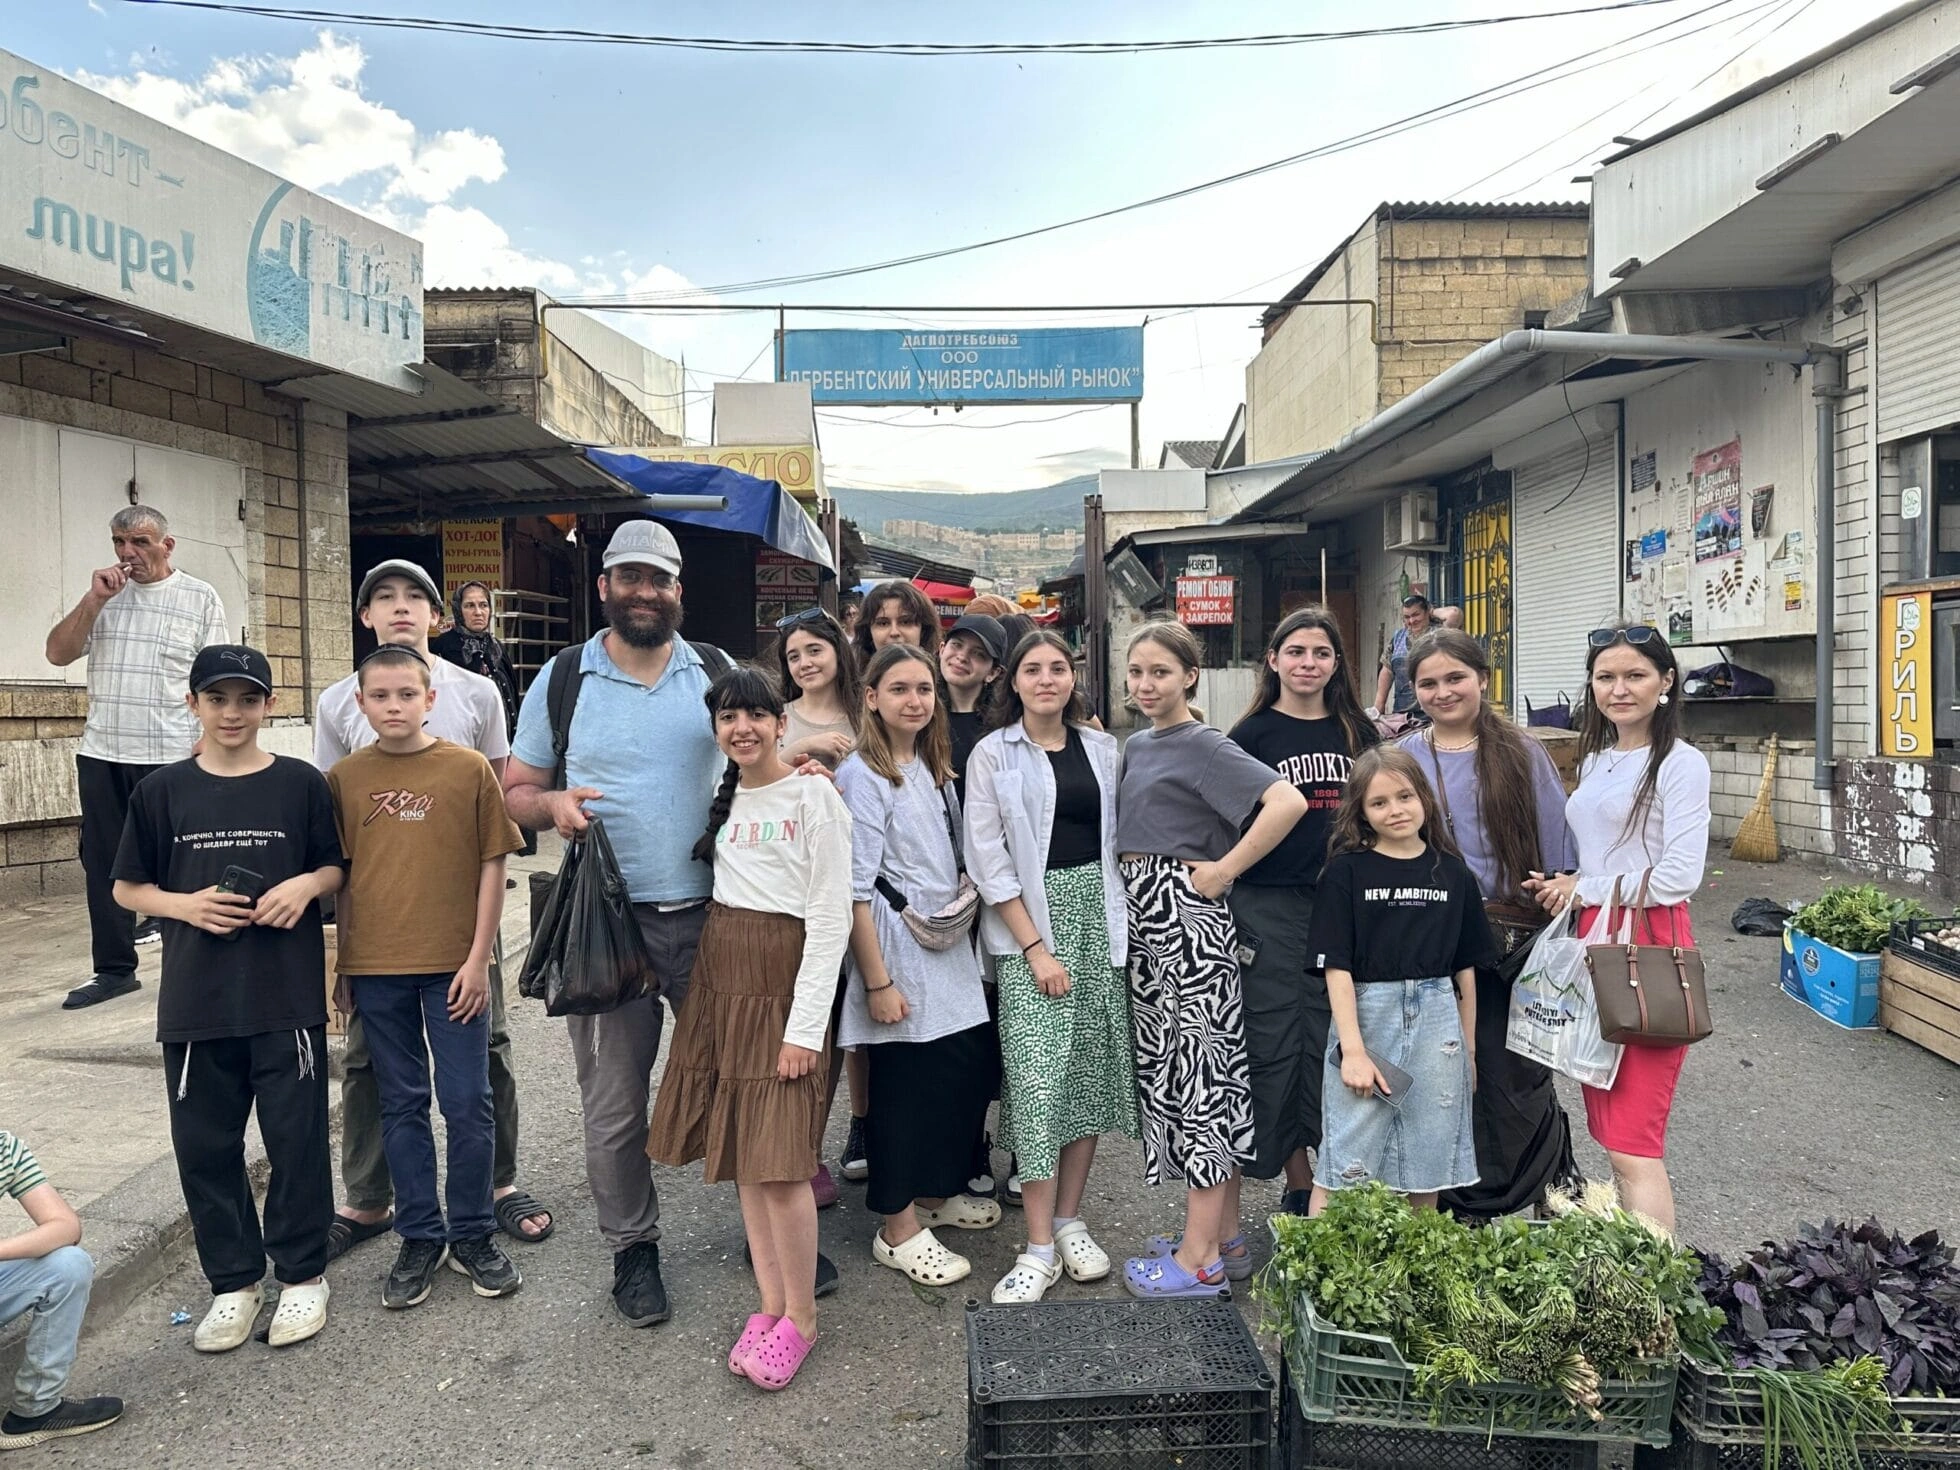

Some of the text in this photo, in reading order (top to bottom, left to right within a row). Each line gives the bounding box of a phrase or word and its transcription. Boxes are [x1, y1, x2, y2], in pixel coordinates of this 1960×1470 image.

[902, 334, 1018, 347] ДАГПОТРЕБСОЮЗ
[941, 351, 979, 364] ООО
[917, 364, 1065, 390] УНИВЕРСАЛЬНЫЙ
[445, 530, 499, 544] ХОТ-ДОГ
[445, 548, 501, 557] КУРЫ-ГРИЛЬ
[445, 563, 500, 573] ПИРОЖКИ
[1177, 580, 1233, 598] РЕМОНТ ОБУВИ
[1189, 601, 1220, 611] СУМОК
[1889, 597, 1919, 753] ГРИЛЬ
[1277, 752, 1356, 787] BROOKLY
[1313, 789, 1339, 797] 1898
[1325, 799, 1343, 809] YOR
[400, 809, 426, 818] KING
[203, 840, 234, 849] ШЕДЕВР
[1364, 887, 1448, 902] NEW AMBITION
